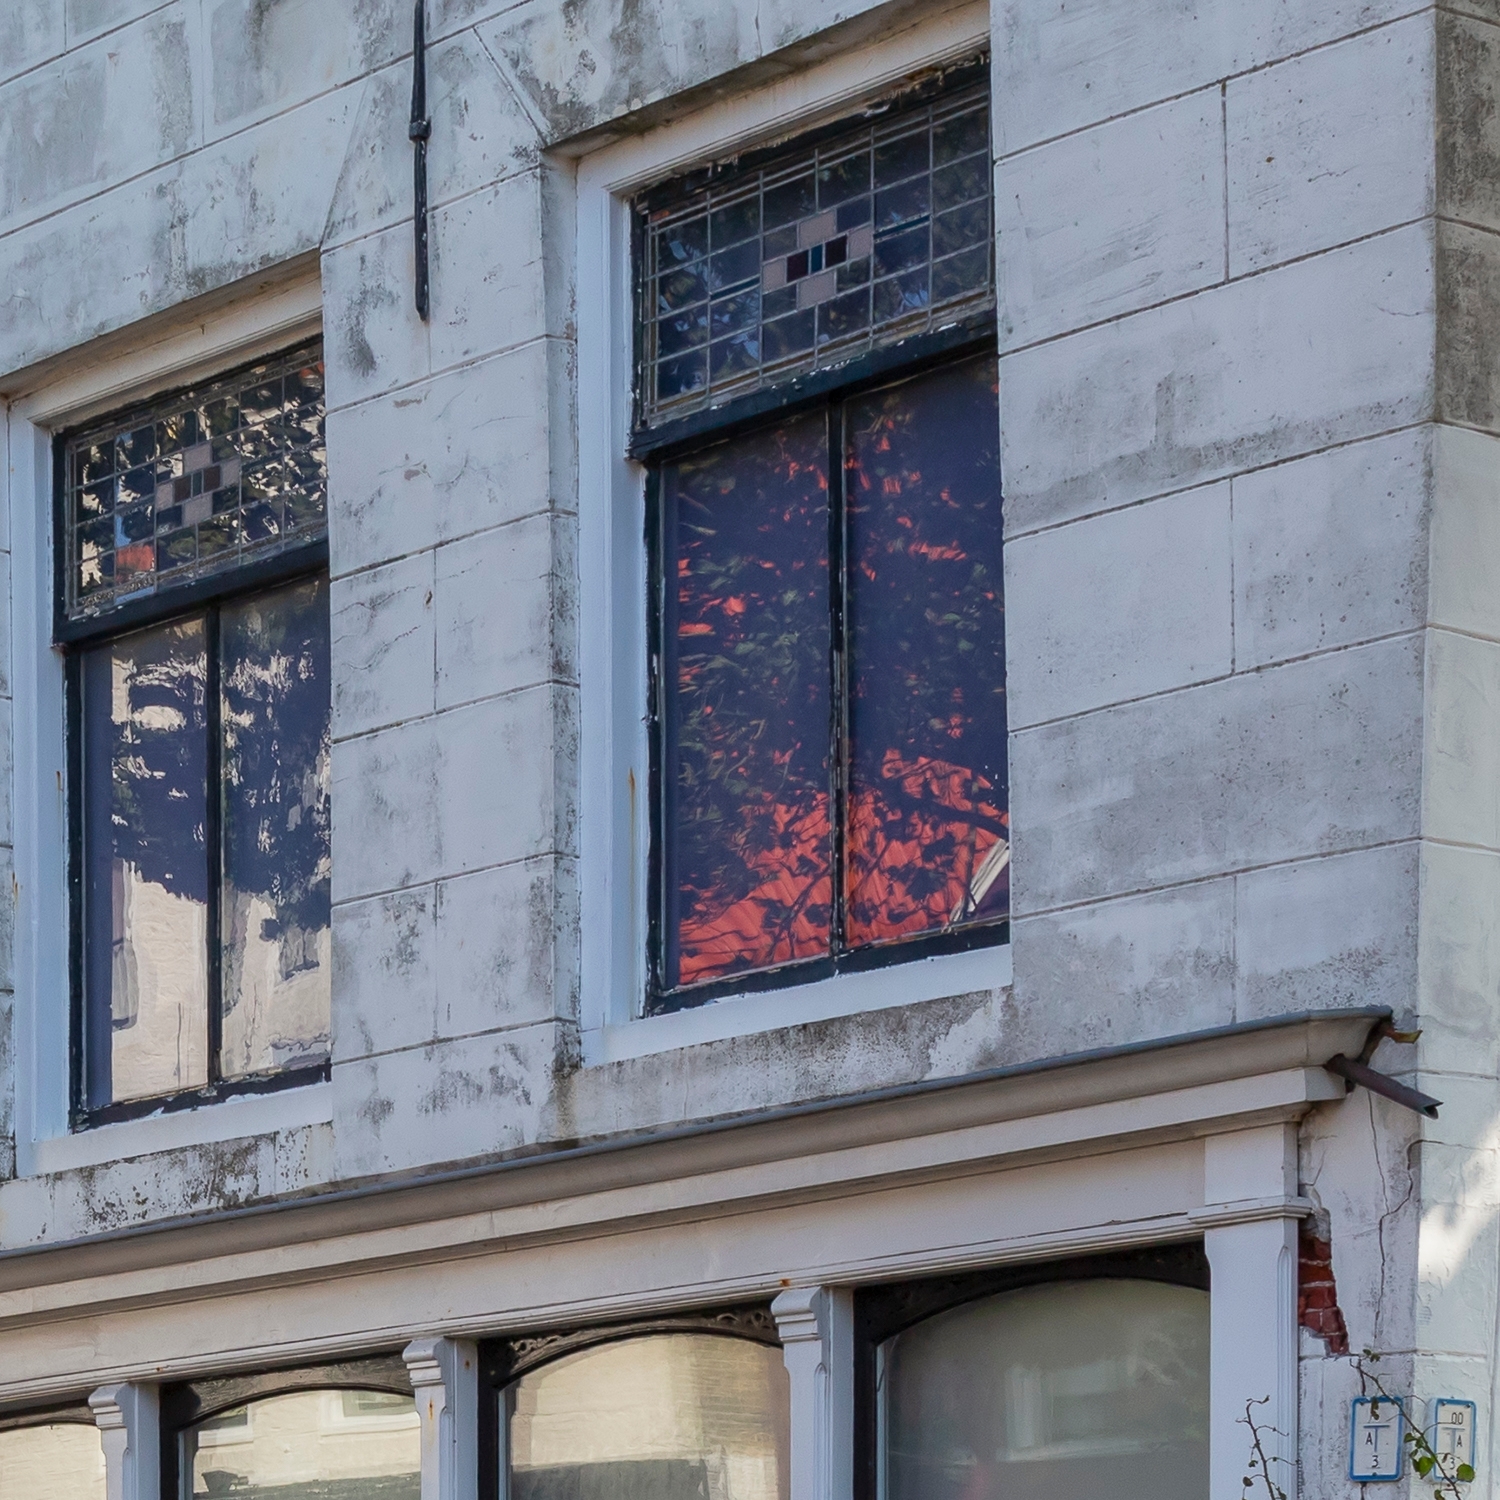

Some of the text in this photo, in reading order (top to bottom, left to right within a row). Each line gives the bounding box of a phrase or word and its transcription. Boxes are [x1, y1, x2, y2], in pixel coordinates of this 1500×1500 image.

[1365, 1432, 1372, 1445] A
[1456, 1435, 1463, 1448] A
[1371, 1455, 1379, 1468] 3
[1450, 1457, 1456, 1470] 3
